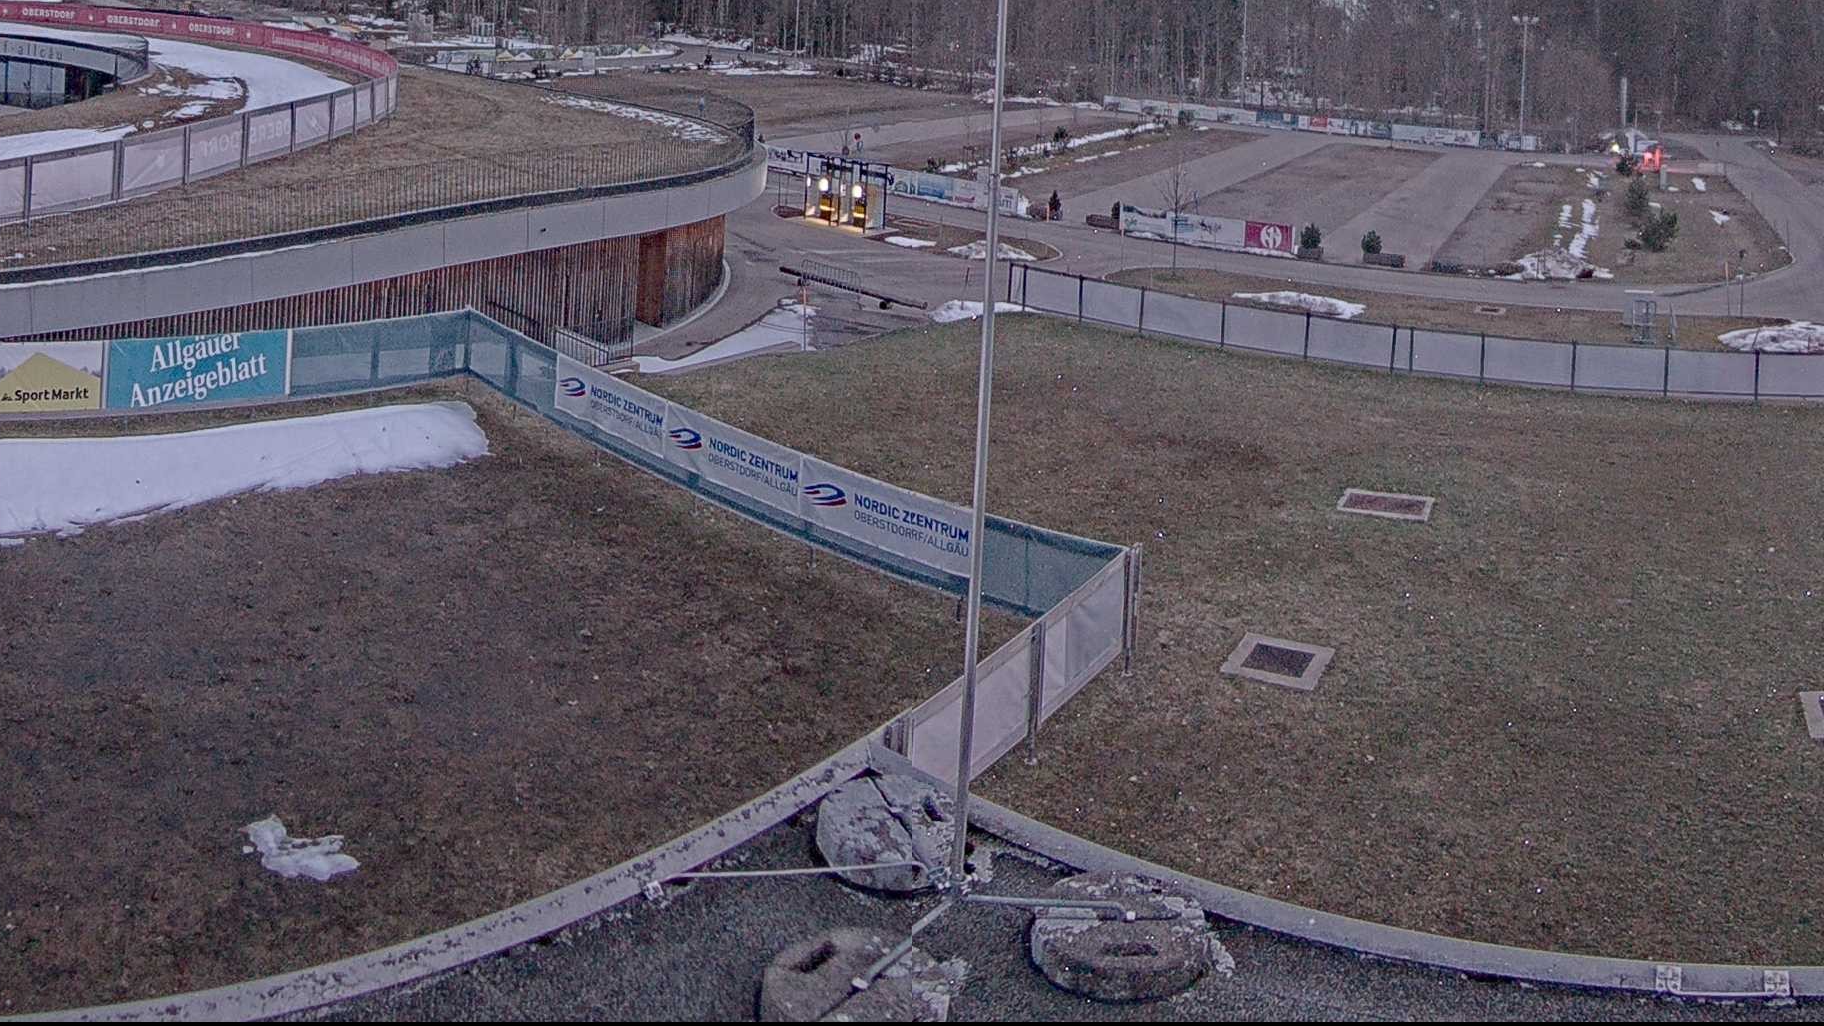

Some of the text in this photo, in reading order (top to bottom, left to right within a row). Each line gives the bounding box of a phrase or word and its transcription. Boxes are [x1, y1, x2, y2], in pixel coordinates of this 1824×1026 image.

[22, 7, 75, 19] OBERSTDORF
[107, 14, 160, 27] OBERSTDORF
[188, 22, 235, 36] OBERSTDORF
[150, 332, 241, 373] Allgäuer
[130, 352, 268, 409] Anzeigeblatt
[590, 384, 664, 427] NORDIC ZENTRUM
[709, 437, 799, 484] NORDIC ZENTRUM
[854, 493, 900, 519] NORDIC
